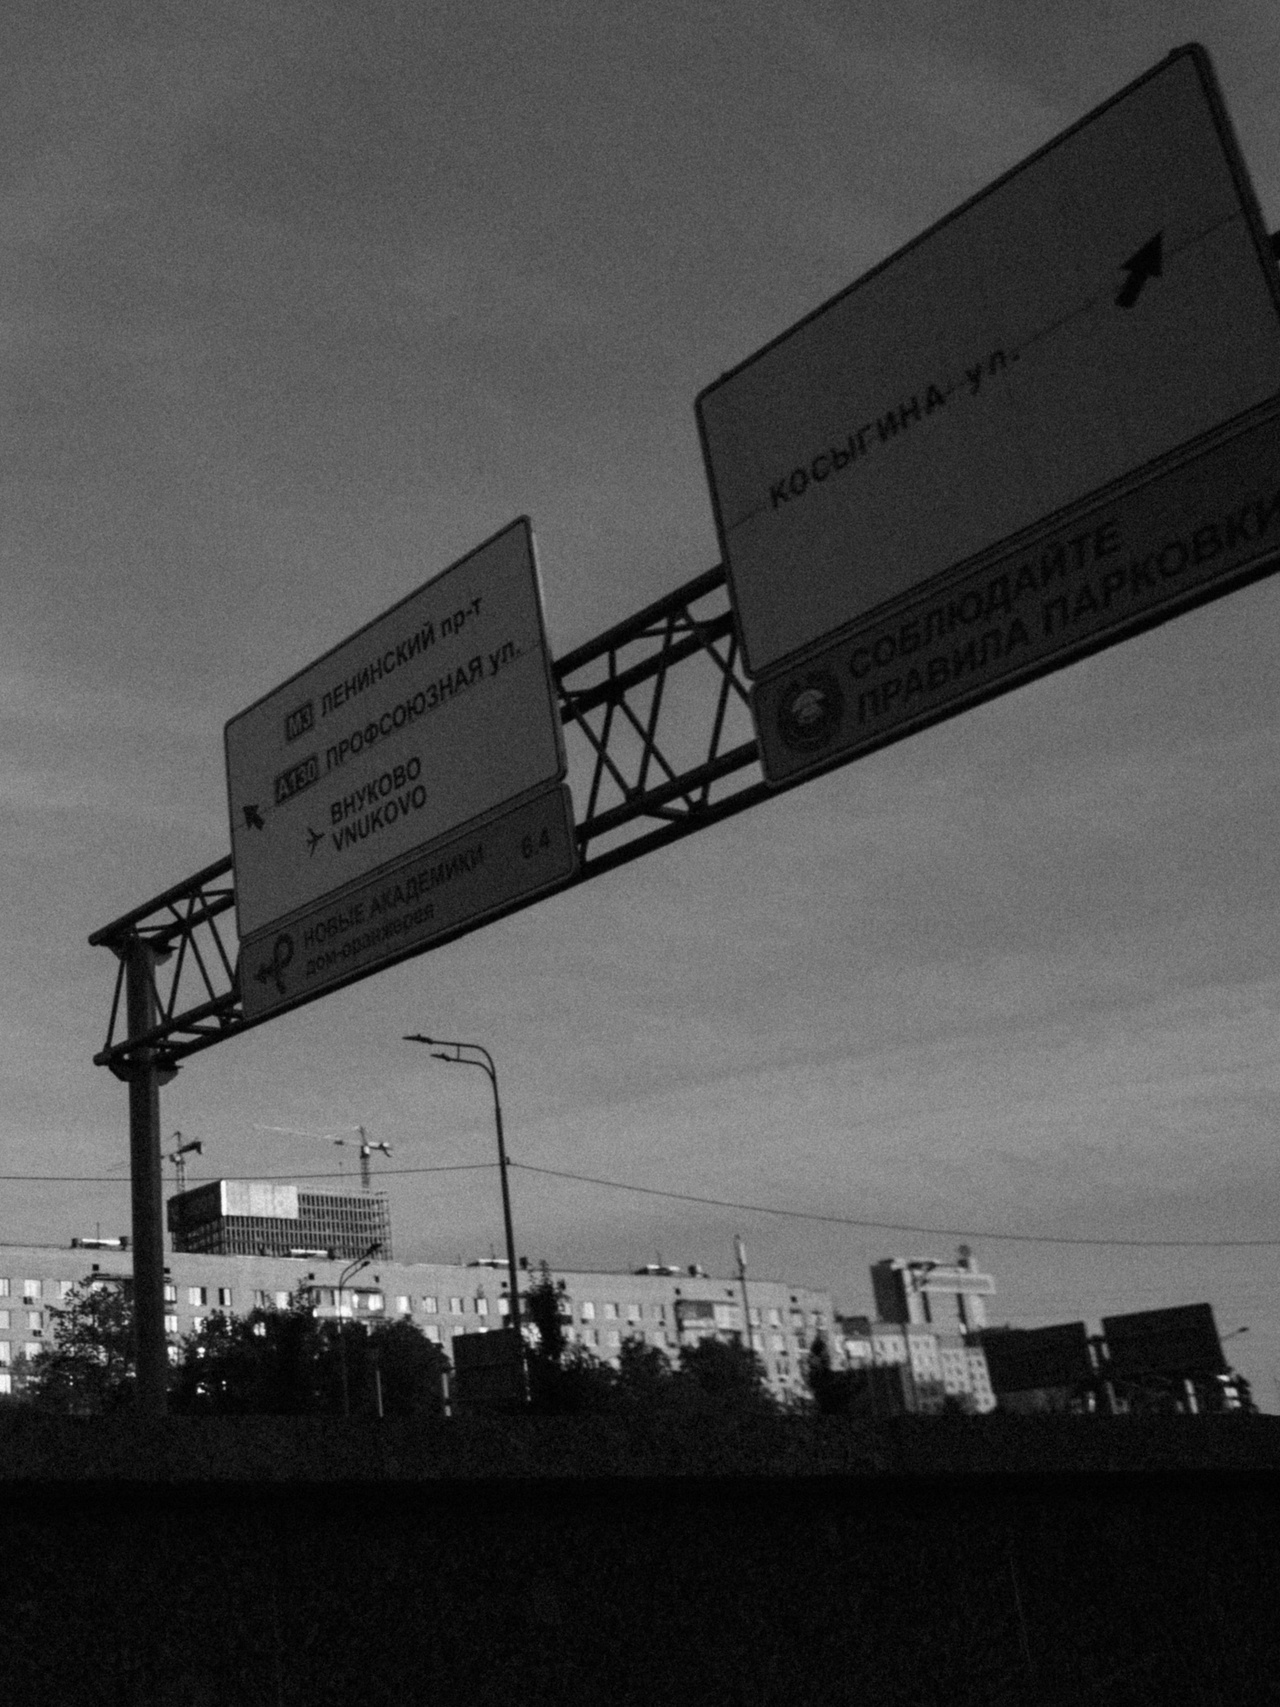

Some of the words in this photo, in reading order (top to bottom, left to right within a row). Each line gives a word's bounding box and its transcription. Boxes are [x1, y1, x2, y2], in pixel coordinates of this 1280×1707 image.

[769, 384, 946, 507] КОСЫГИНА
[965, 349, 1020, 395] ул.
[321, 623, 437, 716] ЛЕНИНСКИЙ
[441, 597, 483, 639] пр-т
[849, 521, 1120, 680] СОБЛЮДАЙТЕ
[858, 617, 1029, 724] ПРАВИЛА
[1043, 488, 1280, 635] ПАРКОВКИ
[326, 656, 483, 770] ПРОФСОЮЗНАЯ
[488, 642, 521, 676] ул.
[330, 757, 420, 825] ВНУКОВО
[332, 785, 426, 851] VNUKOVO
[303, 903, 363, 947] НОВЫЕ
[370, 845, 483, 921] АКАДЕМИКИ
[522, 826, 550, 859] 6.4
